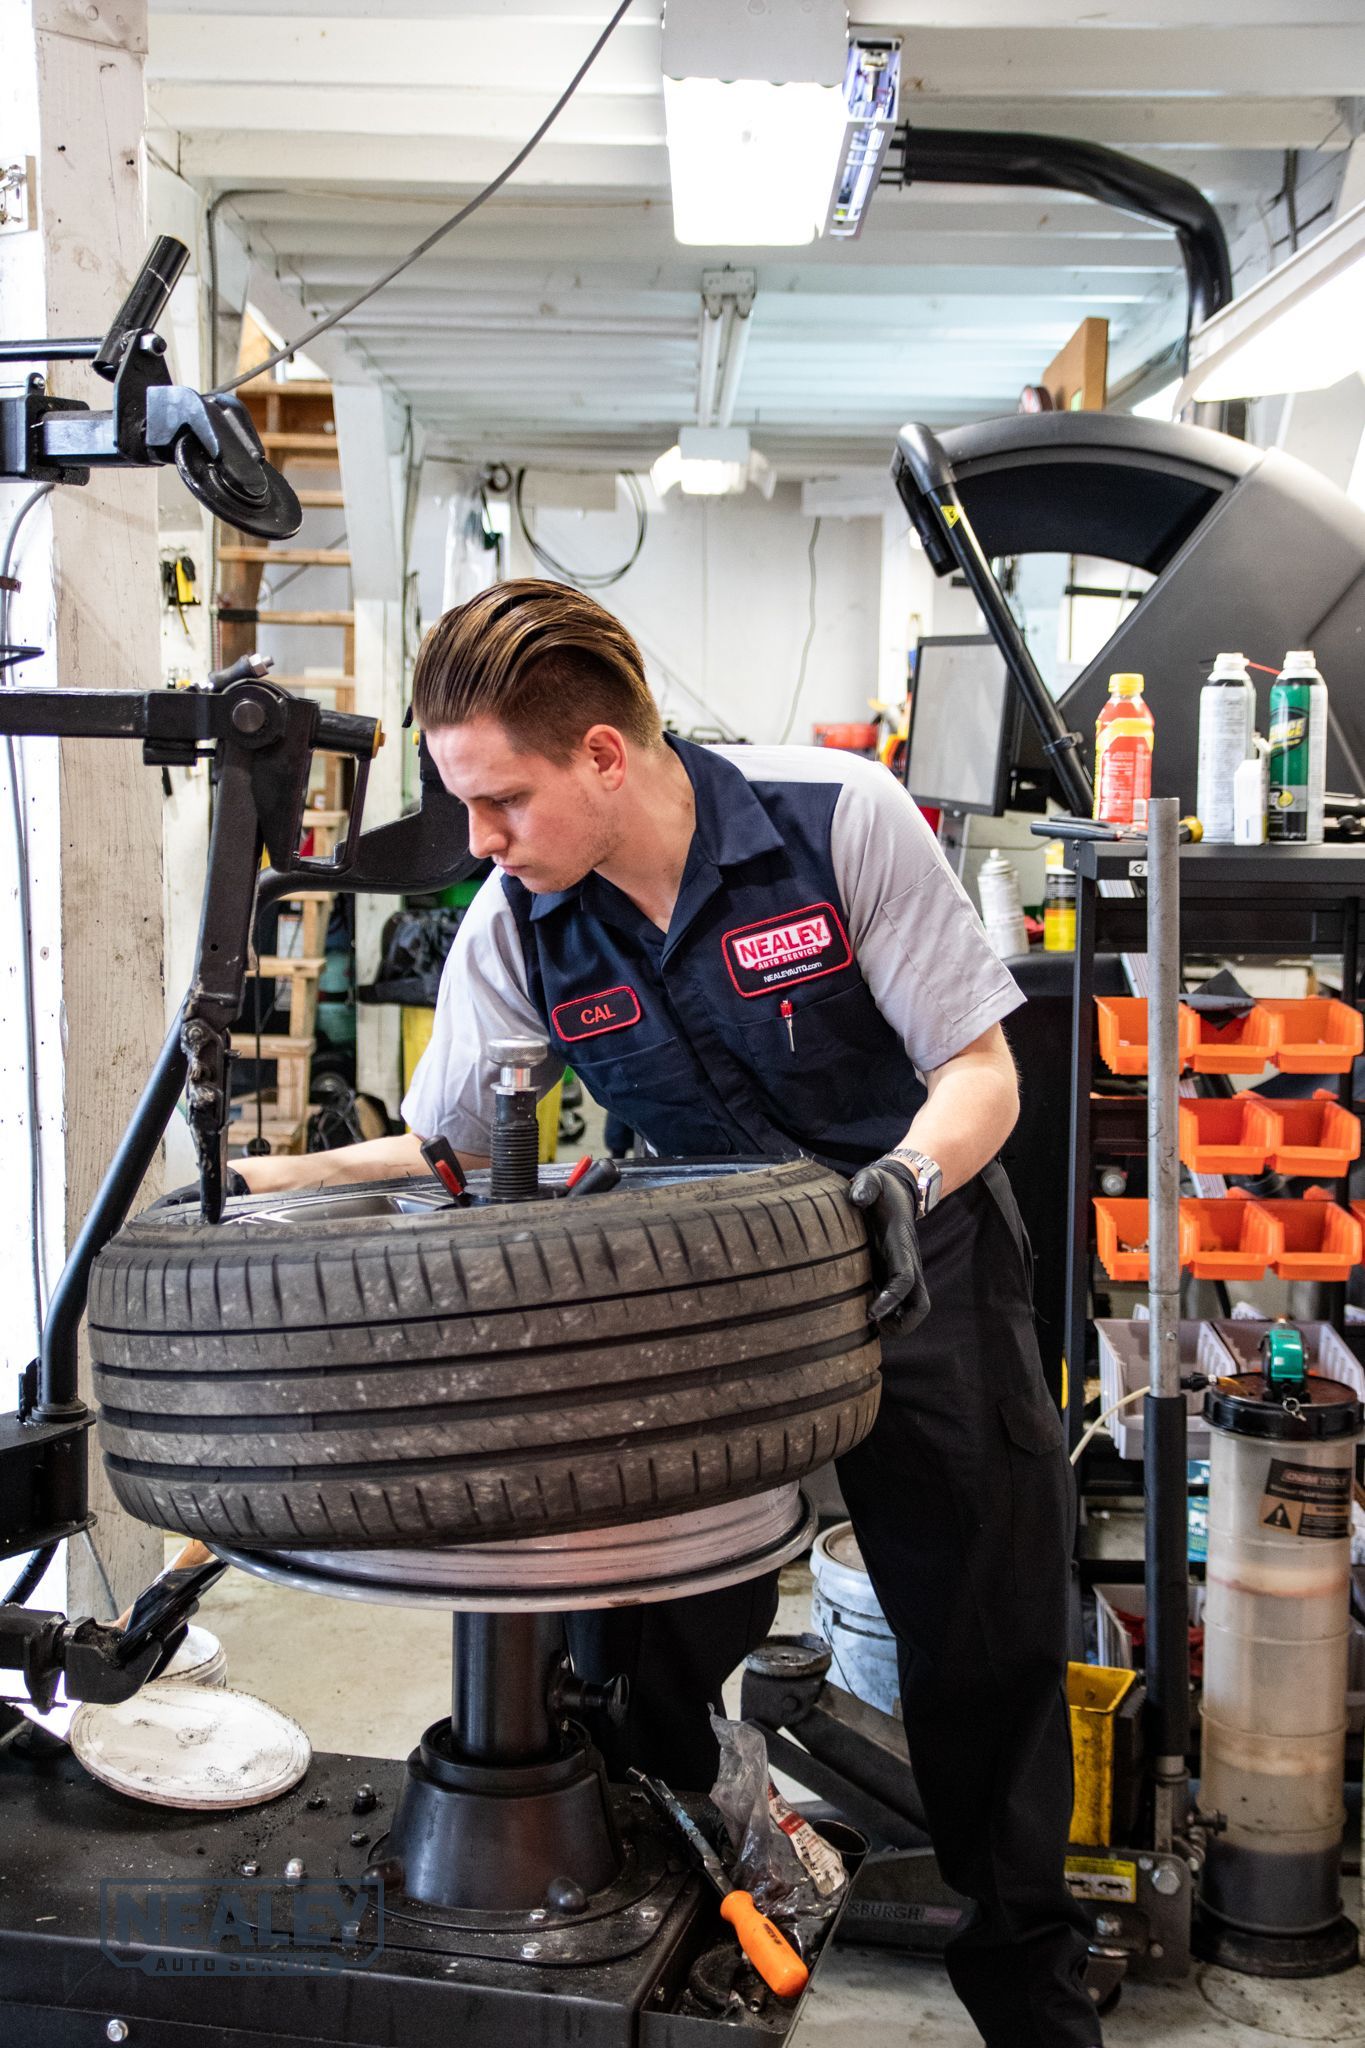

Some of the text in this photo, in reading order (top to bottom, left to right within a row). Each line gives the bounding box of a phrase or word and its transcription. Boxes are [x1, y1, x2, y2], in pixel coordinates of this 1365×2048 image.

[738, 921, 823, 963] NEALEY
[758, 946, 819, 970] AUTO SERVICE
[763, 962, 823, 983] NEALEYAUTO.com
[581, 1003, 616, 1025] CAL
[850, 1902, 921, 1921] SBURGH
